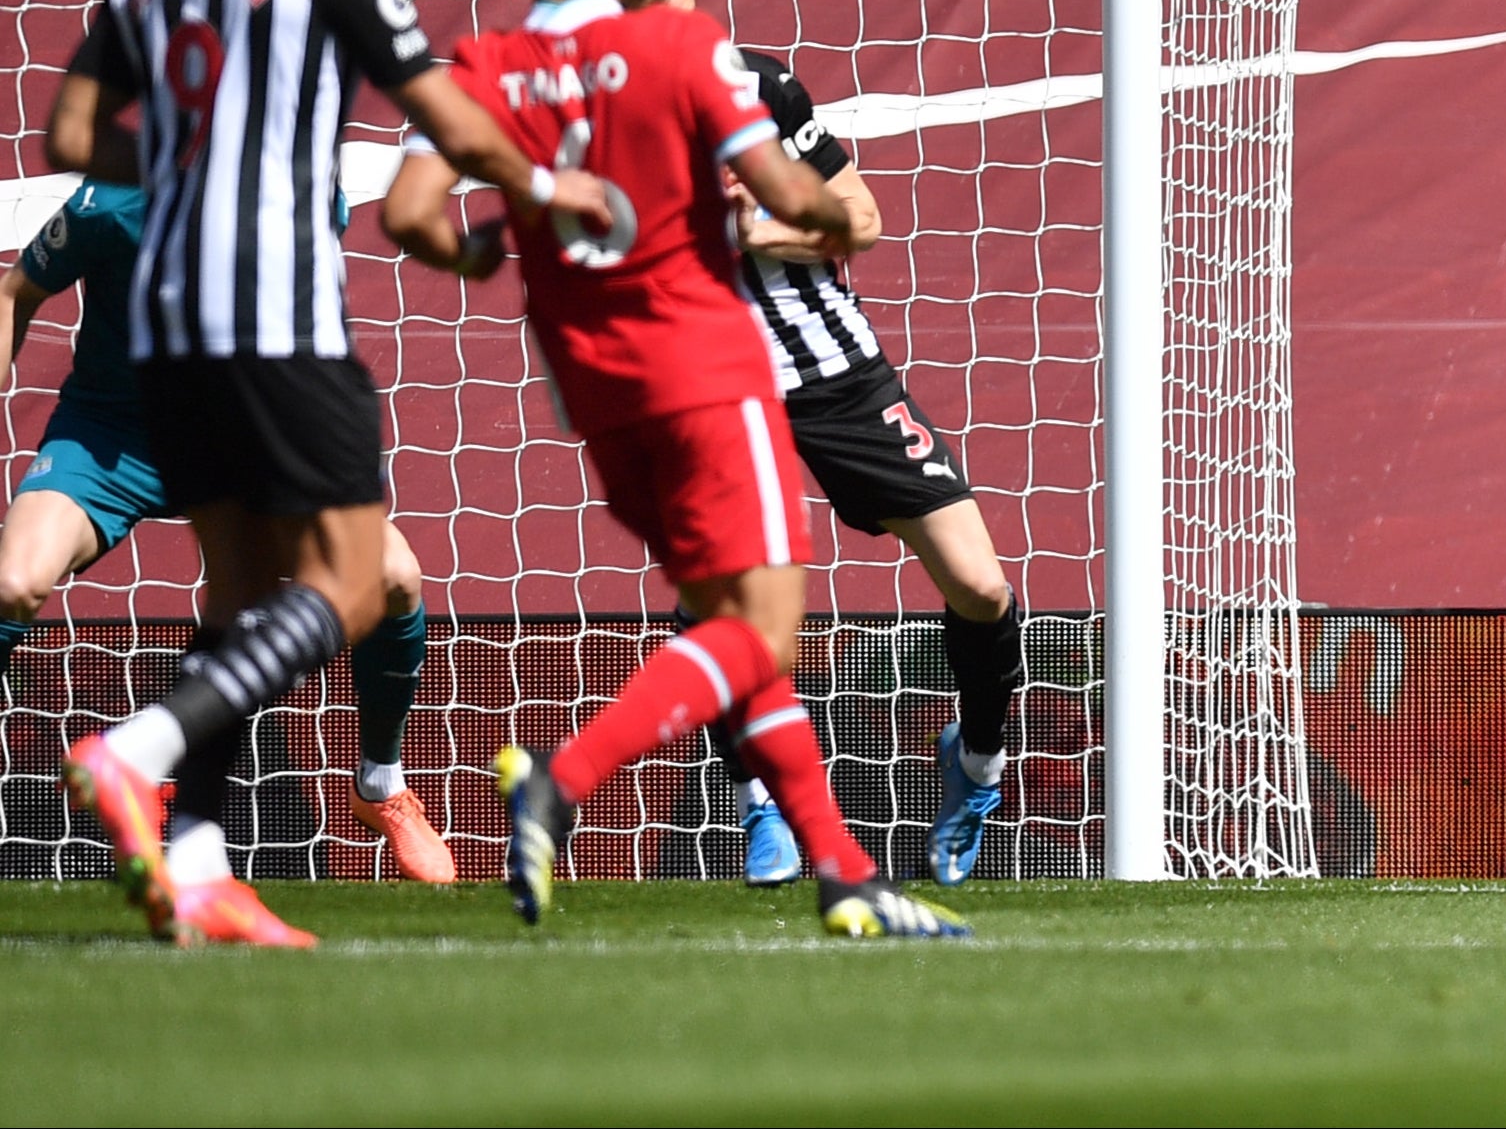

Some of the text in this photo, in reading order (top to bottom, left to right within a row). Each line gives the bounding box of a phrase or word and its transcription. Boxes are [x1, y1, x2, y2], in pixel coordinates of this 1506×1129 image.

[165, 20, 226, 170] 9
[551, 119, 638, 268] 6
[882, 401, 934, 460] 3
